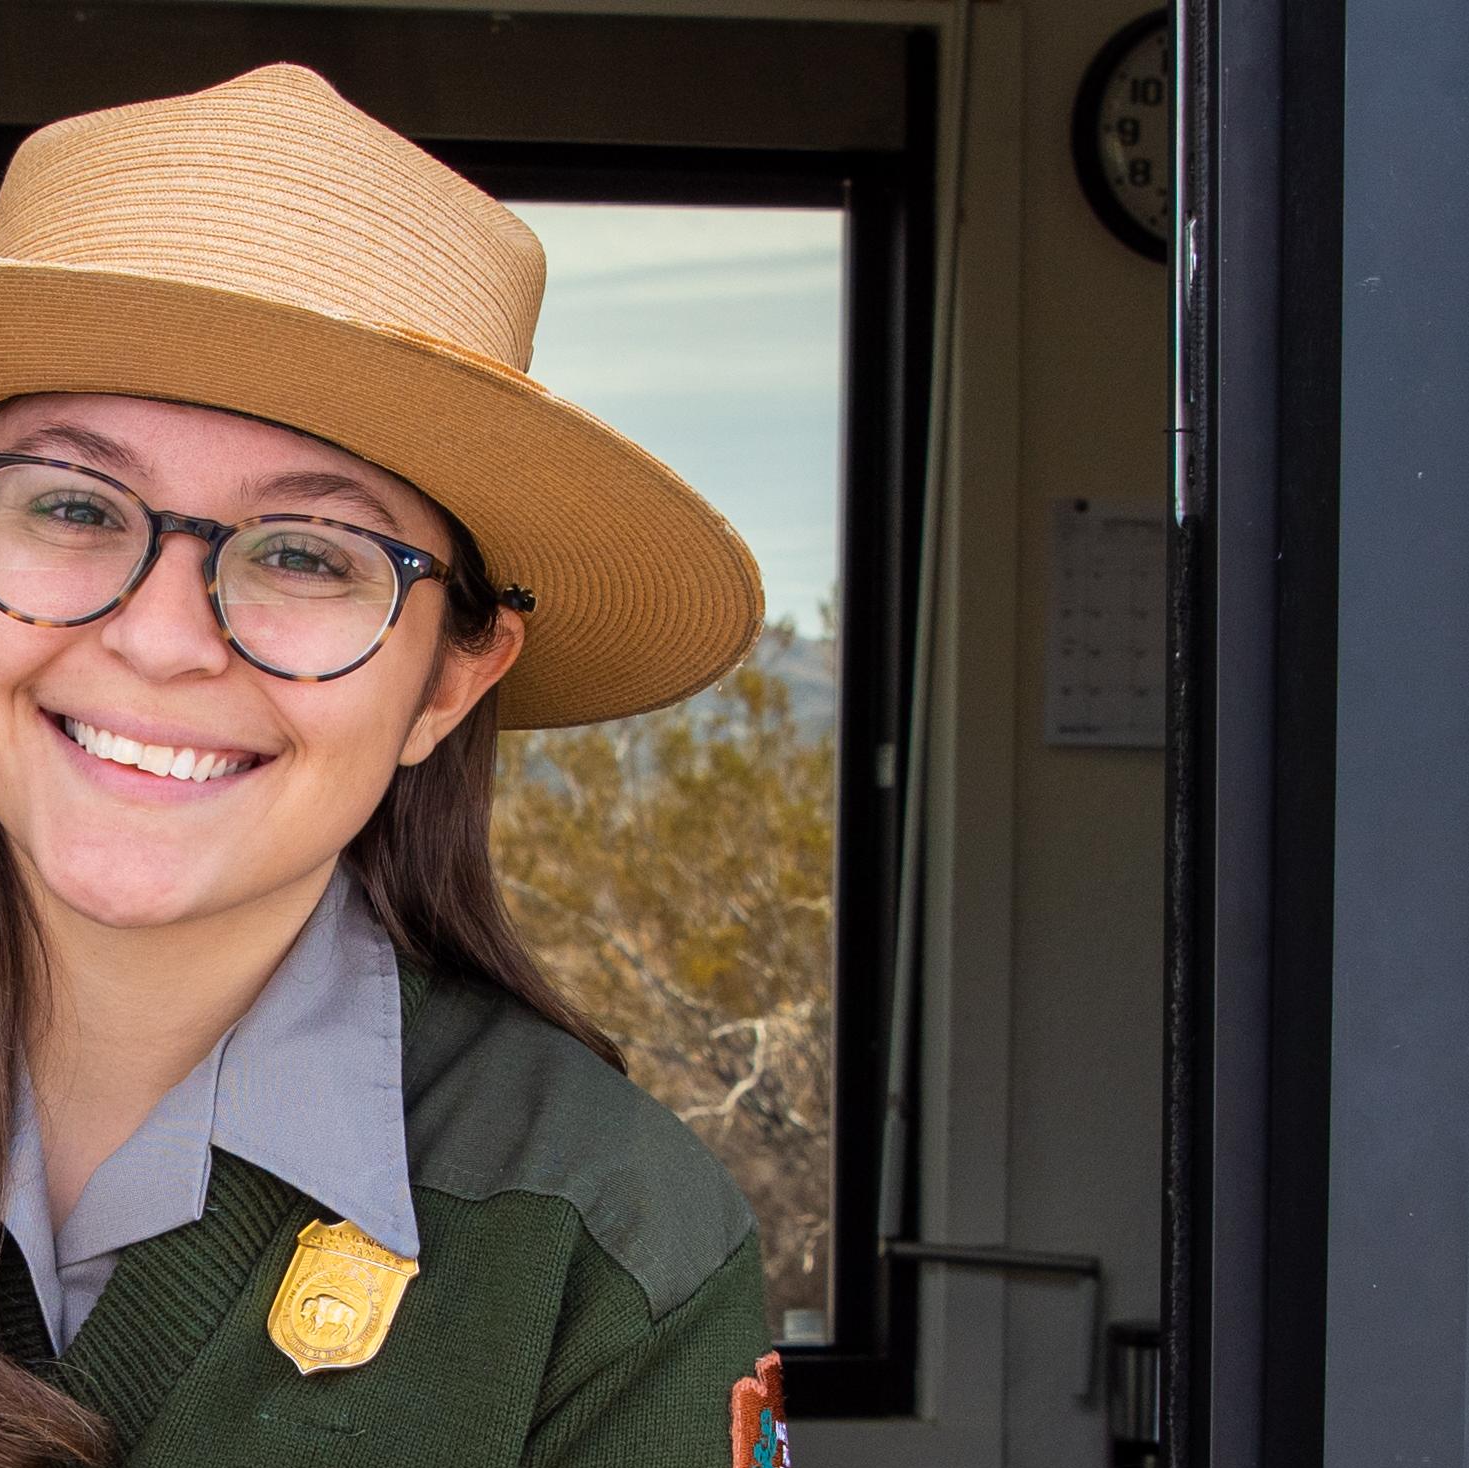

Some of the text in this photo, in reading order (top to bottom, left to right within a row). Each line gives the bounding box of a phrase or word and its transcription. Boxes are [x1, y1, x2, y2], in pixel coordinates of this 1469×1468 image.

[1131, 79, 1162, 106] 10
[1118, 118, 1140, 146] 9
[1129, 158, 1152, 187] 8
